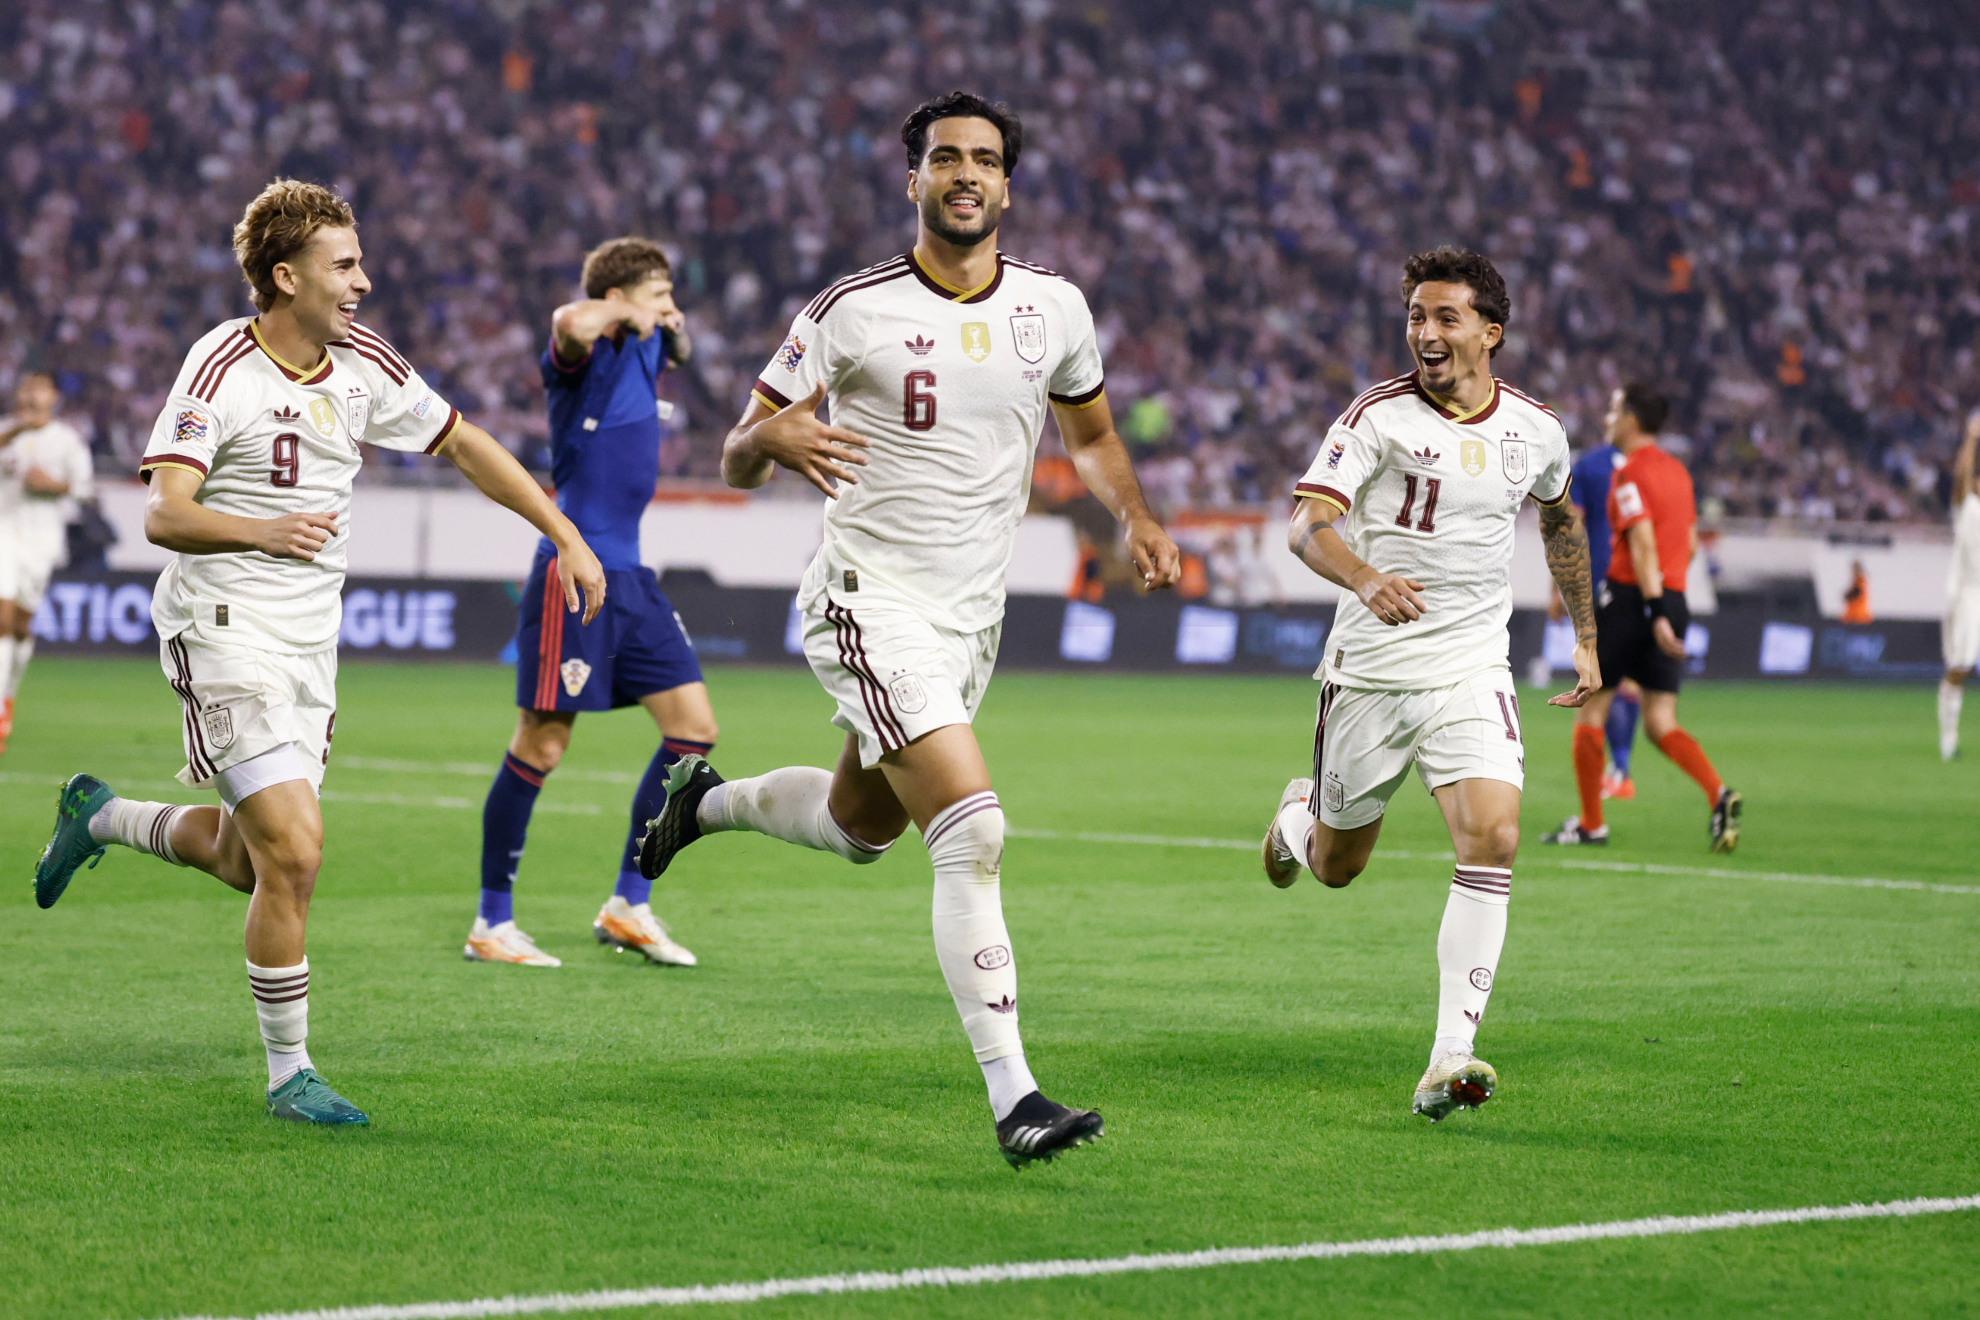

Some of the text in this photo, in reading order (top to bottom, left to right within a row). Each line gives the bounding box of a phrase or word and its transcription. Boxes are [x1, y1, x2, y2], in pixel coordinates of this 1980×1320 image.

[903, 370, 937, 432] 6
[270, 432, 300, 488] 9
[1395, 473, 1441, 534] 11
[29, 583, 152, 644] ATIO
